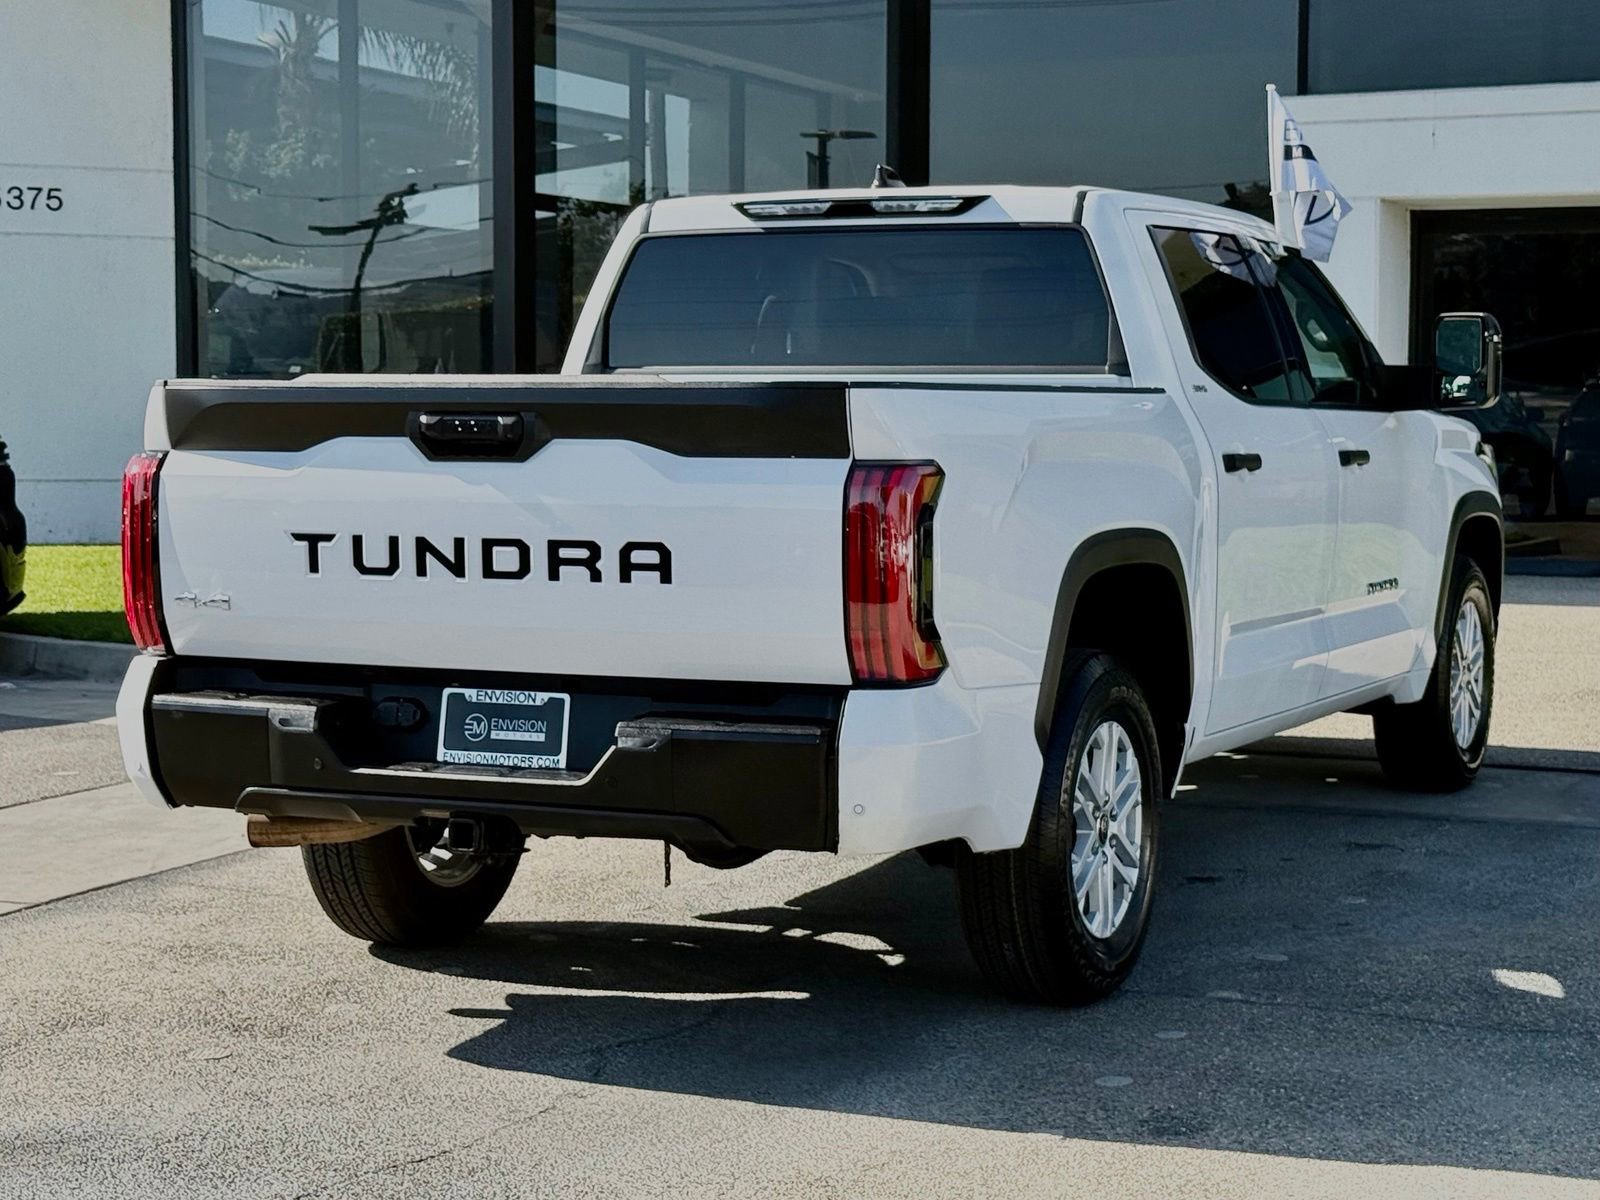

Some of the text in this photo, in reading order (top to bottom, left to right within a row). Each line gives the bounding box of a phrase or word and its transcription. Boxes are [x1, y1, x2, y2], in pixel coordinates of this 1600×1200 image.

[0, 186, 63, 211] 375
[289, 532, 672, 584] TUNDRA
[476, 690, 537, 704] ENVISION
[491, 718, 546, 732] ENVISION
[495, 732, 541, 740] MOTORS
[443, 752, 560, 768] ENVISIONMOTORS.COM
